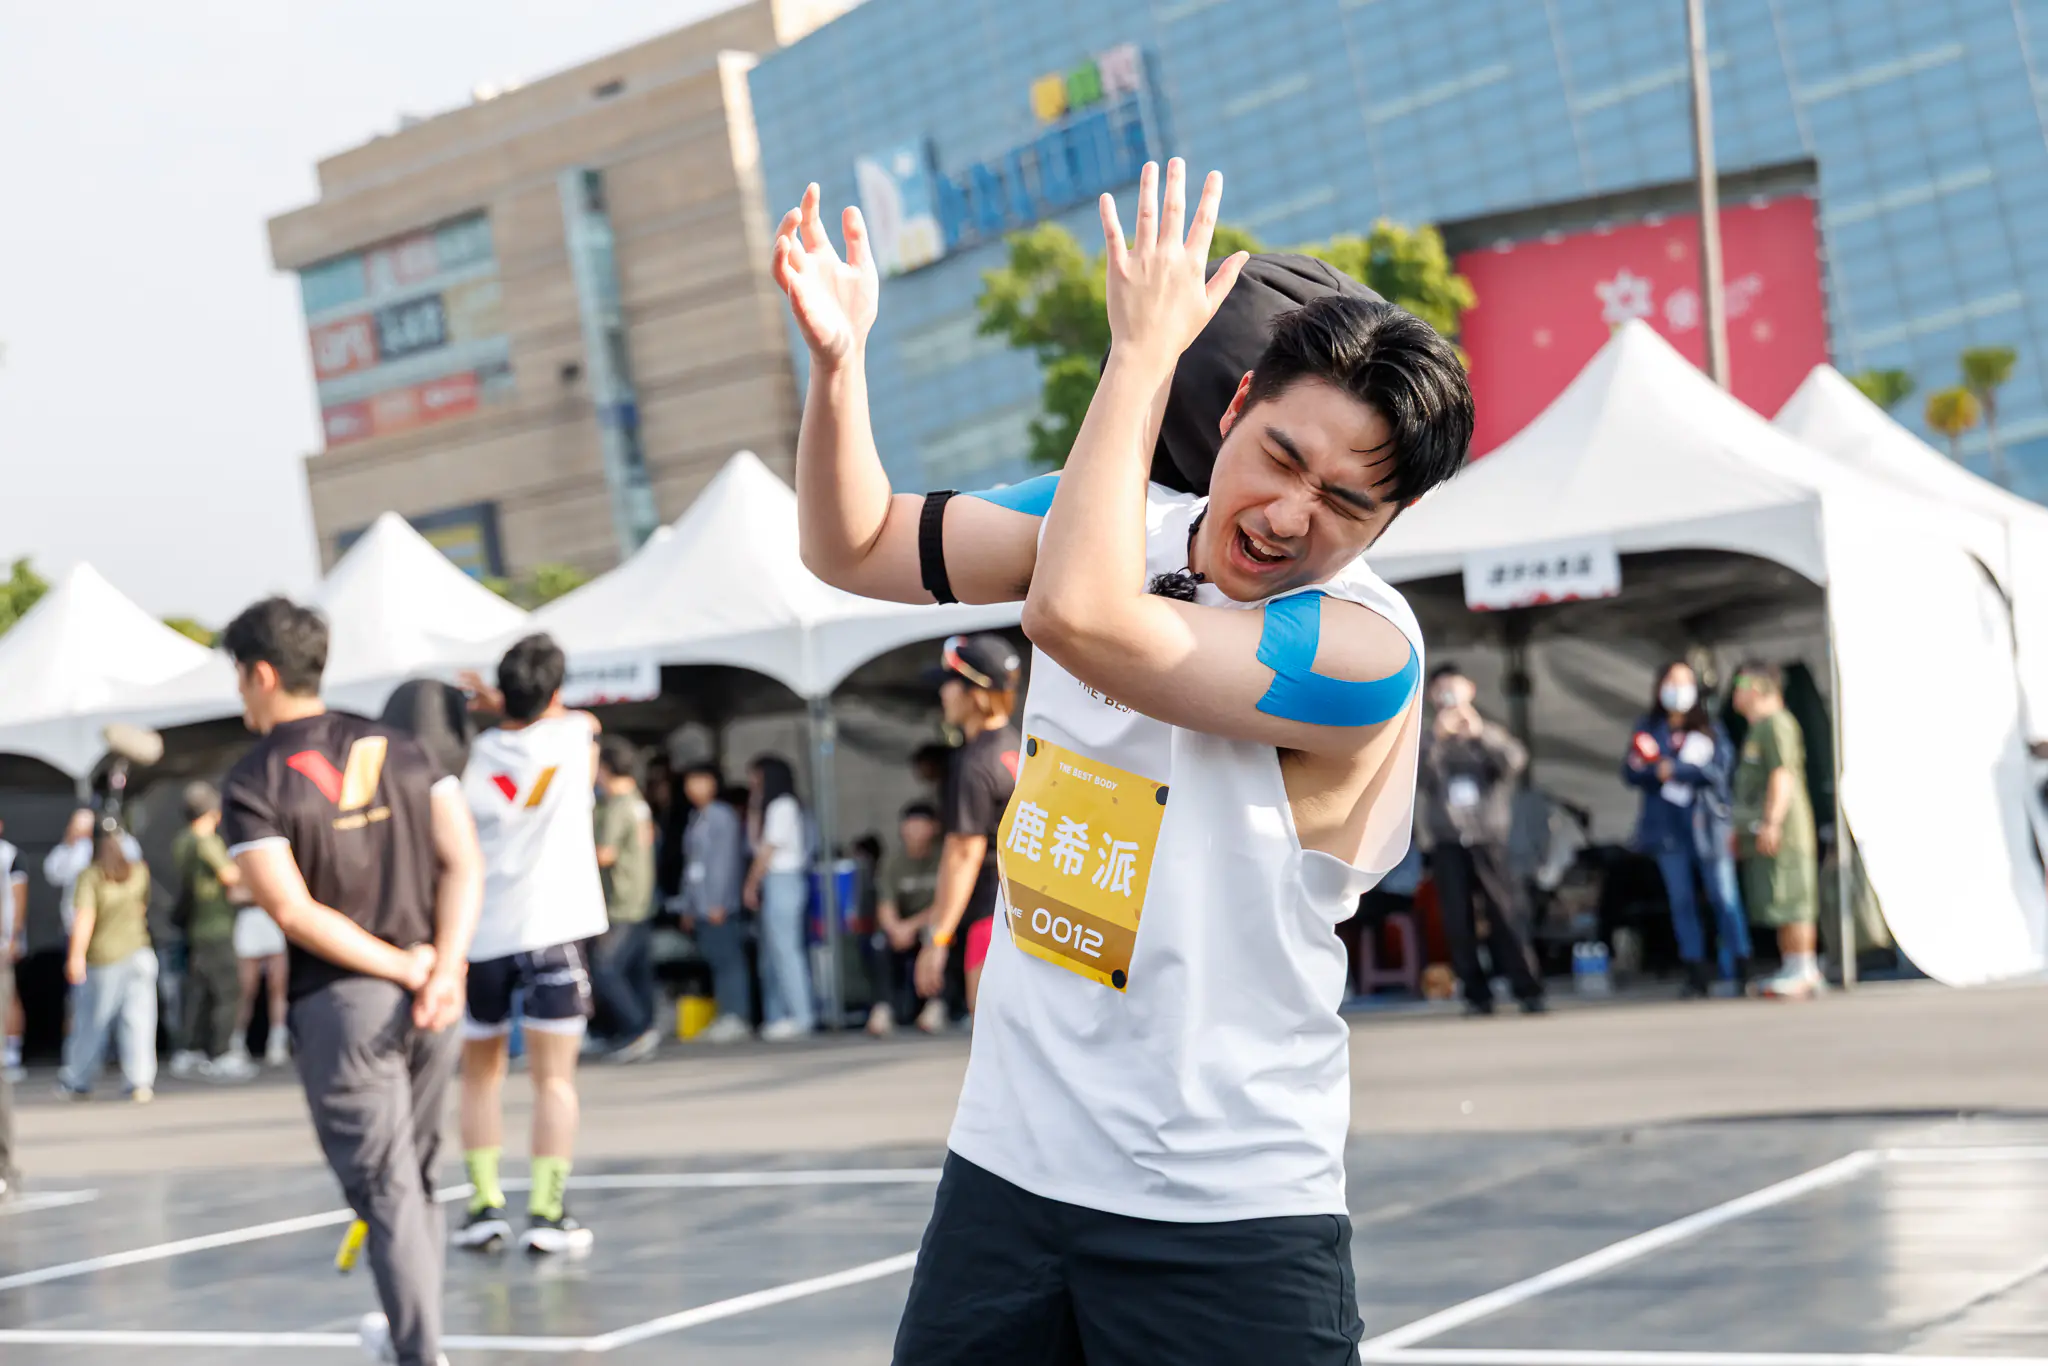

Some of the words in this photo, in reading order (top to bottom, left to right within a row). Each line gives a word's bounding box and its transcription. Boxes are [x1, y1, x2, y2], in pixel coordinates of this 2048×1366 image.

[1059, 762, 1072, 774] THE
[1072, 767, 1093, 782] BEST
[1094, 776, 1118, 791] BODY
[1006, 800, 1139, 897] 鹿希派
[1031, 907, 1104, 958] 0012
